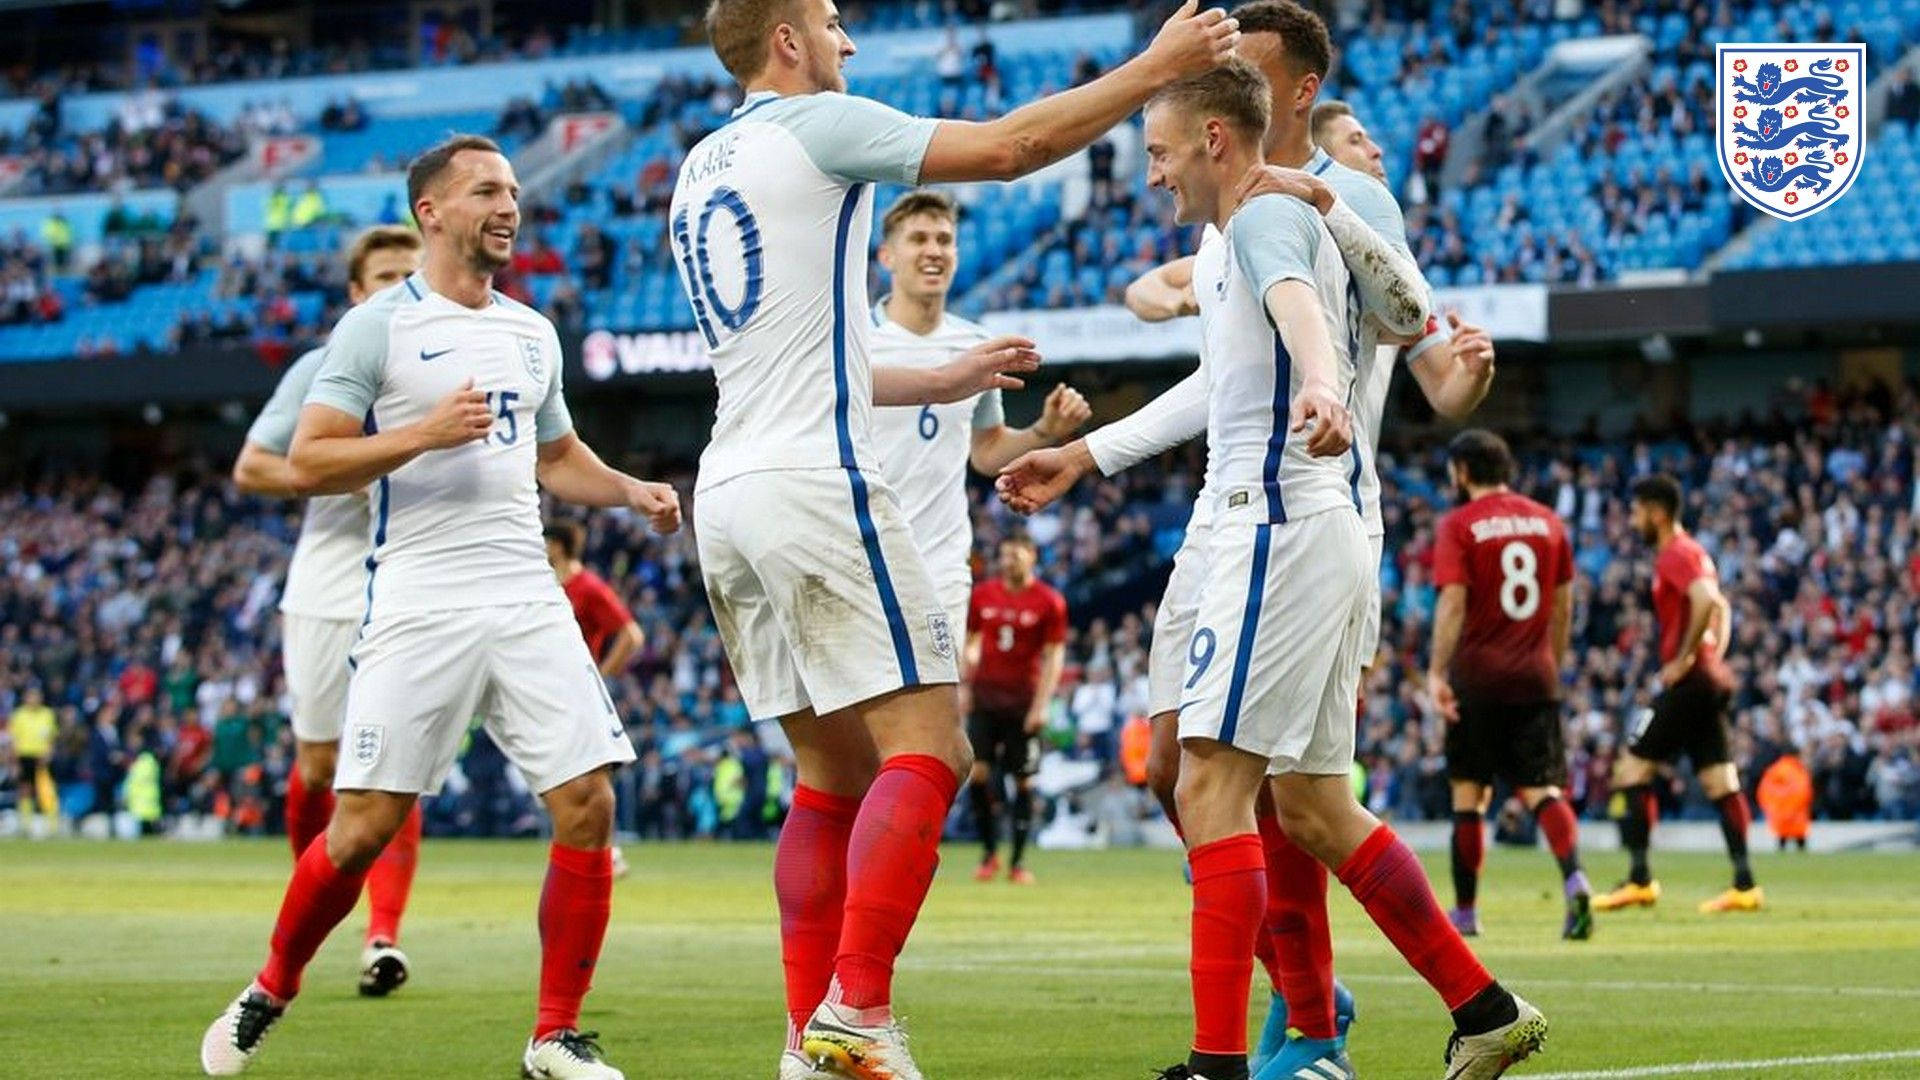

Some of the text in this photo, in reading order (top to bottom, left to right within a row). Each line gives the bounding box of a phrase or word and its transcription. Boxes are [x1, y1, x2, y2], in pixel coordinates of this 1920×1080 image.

[673, 185, 764, 349] 10
[919, 403, 939, 440] 6
[1500, 540, 1541, 621] 8
[1185, 626, 1217, 689] 9
